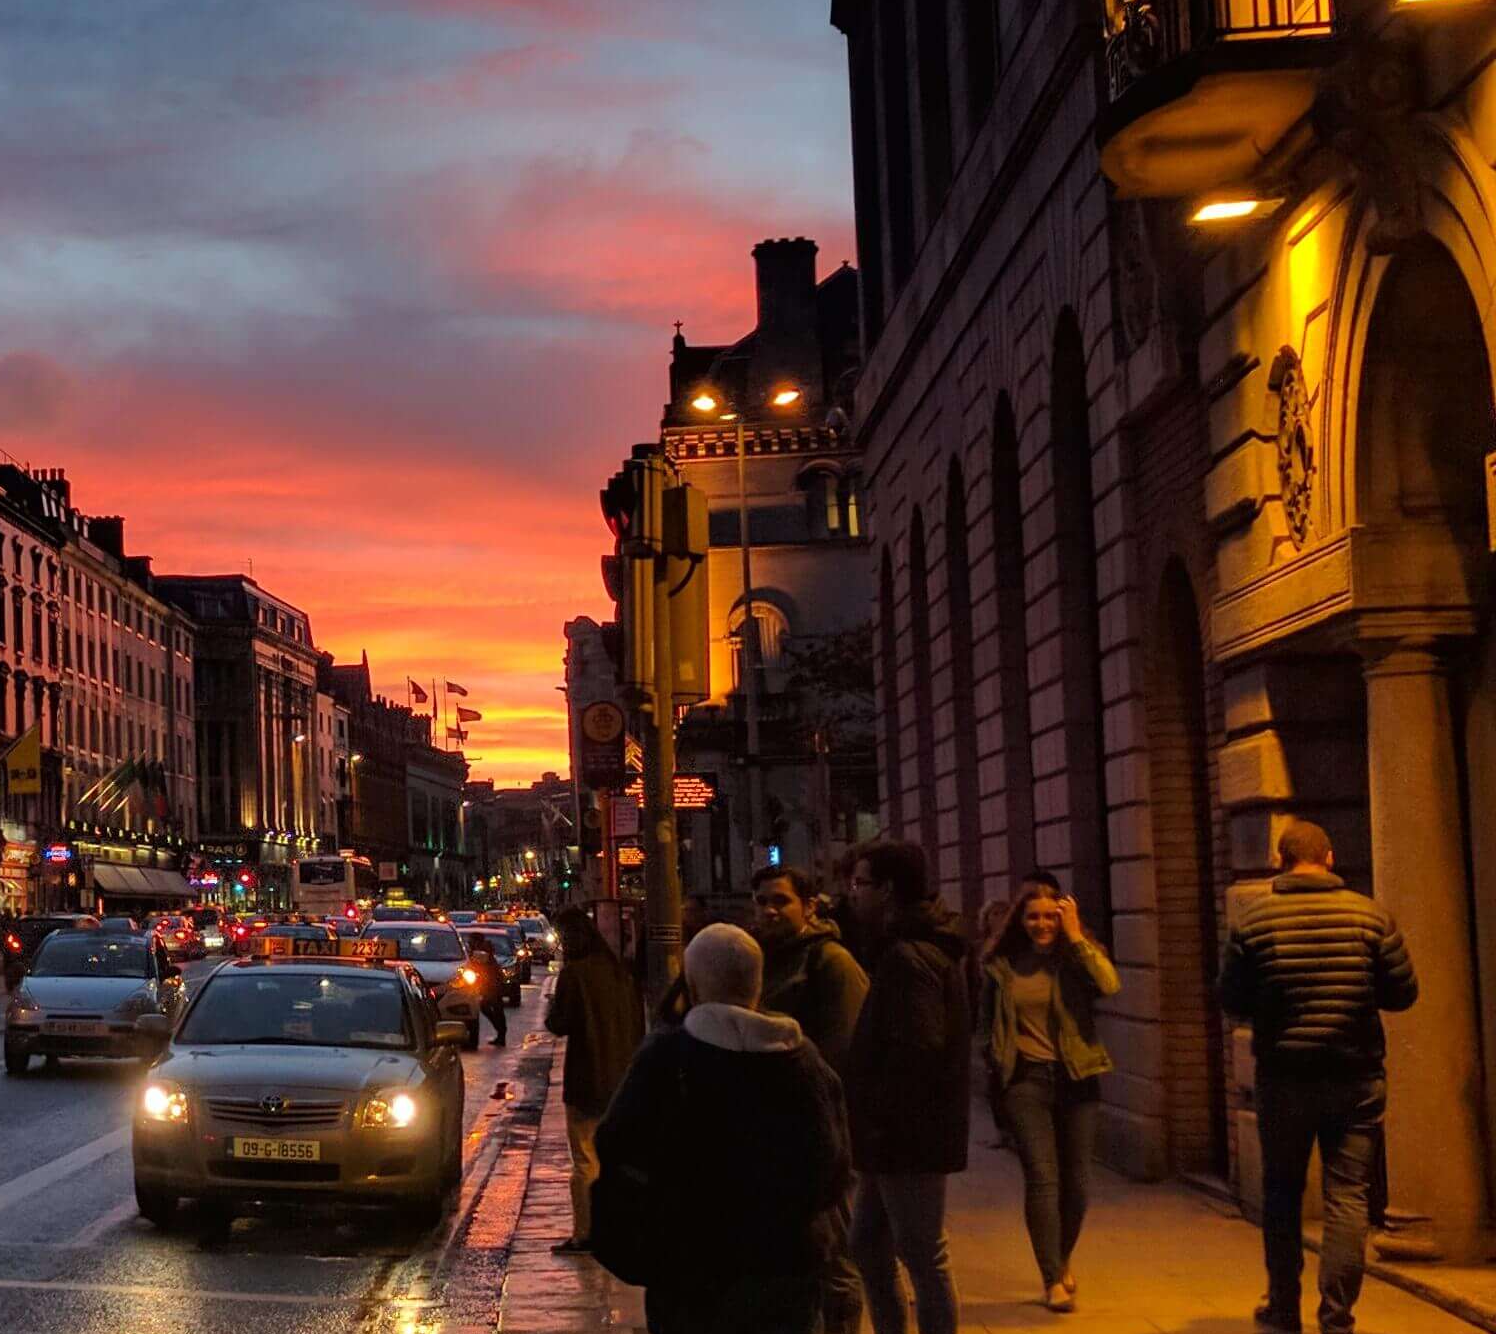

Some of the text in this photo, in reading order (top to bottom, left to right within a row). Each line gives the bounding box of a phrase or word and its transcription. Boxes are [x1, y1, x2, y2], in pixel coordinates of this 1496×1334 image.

[295, 940, 337, 956] TAXI
[351, 942, 388, 956] 22327
[242, 1141, 314, 1158] 09-G-18556
